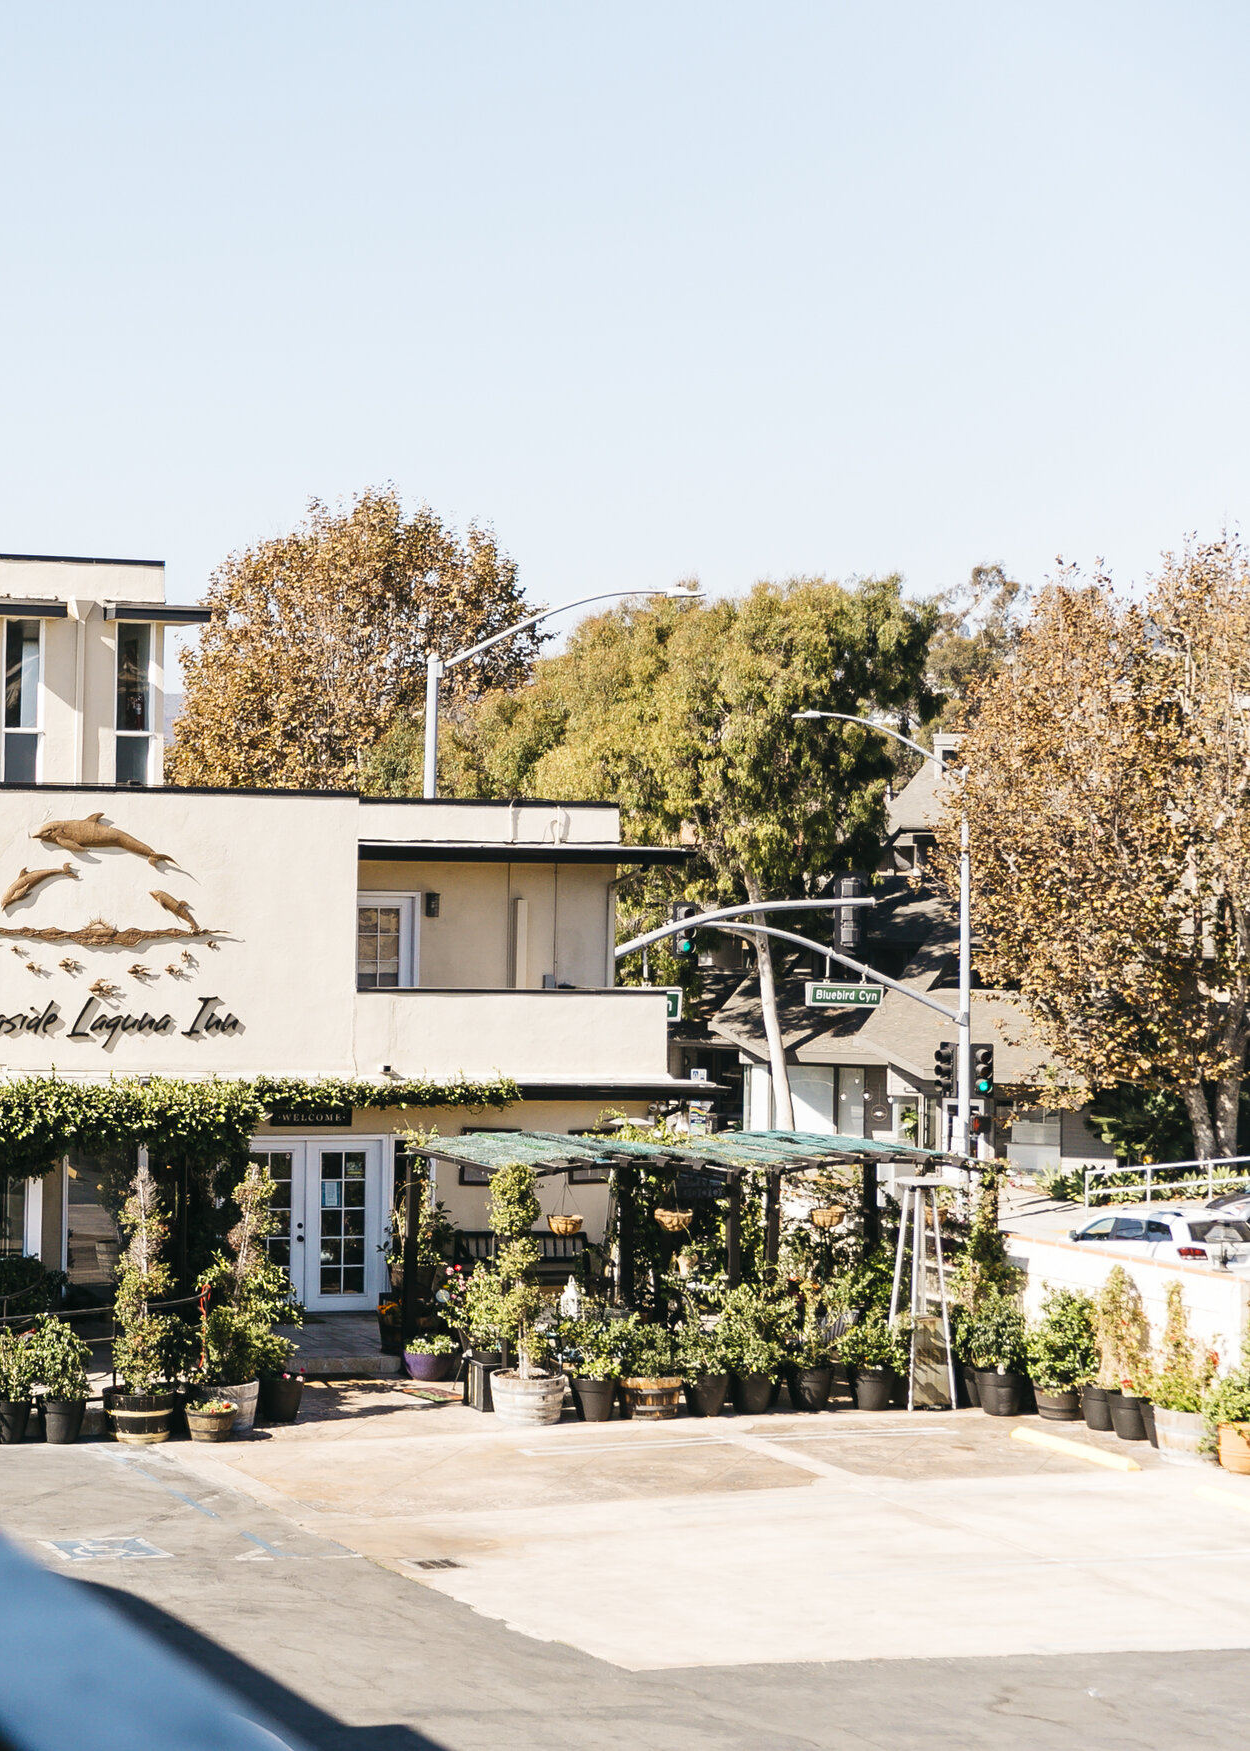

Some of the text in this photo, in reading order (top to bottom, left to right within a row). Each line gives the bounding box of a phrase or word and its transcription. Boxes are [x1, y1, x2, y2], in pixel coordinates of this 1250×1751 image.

[815, 989, 877, 1003] Bluebird Cyn
[66, 996, 172, 1049] Laguna
[181, 996, 240, 1036] Inn
[282, 1113, 342, 1122] WELCOME
